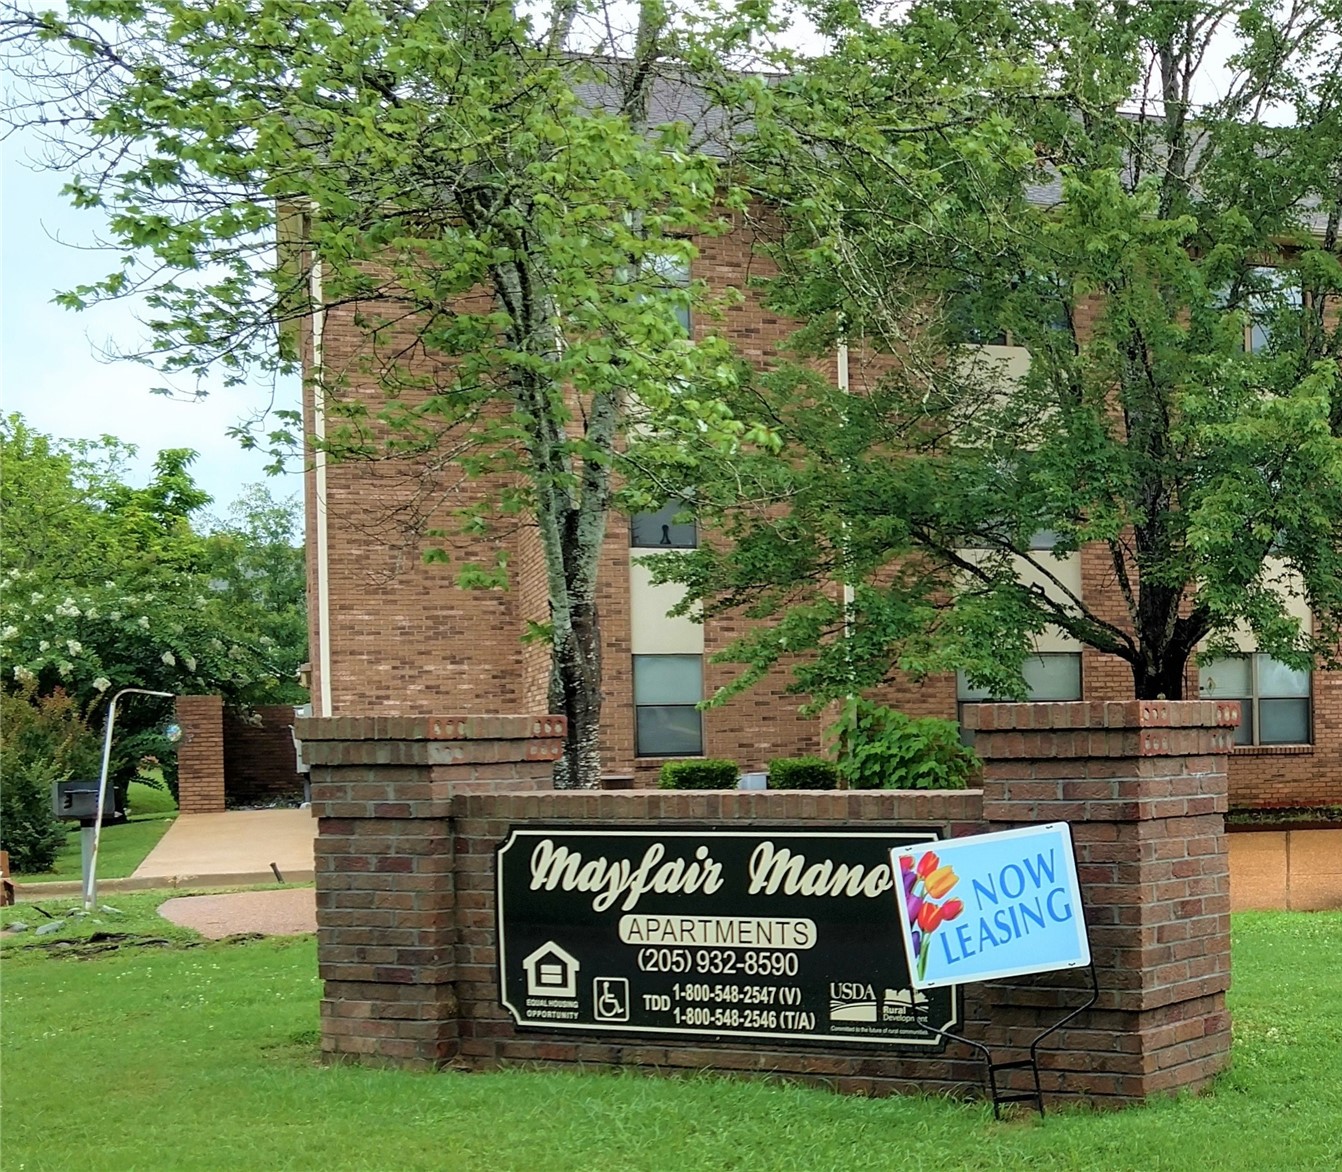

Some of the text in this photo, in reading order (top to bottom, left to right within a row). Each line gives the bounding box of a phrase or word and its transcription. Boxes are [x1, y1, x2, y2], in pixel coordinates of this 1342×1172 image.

[529, 838, 895, 913] Mayfair Mano
[971, 848, 1056, 911] NOW
[626, 917, 810, 947] APARTMENTS
[939, 886, 1073, 965] LEASING
[637, 948, 799, 977] (205) 932-8590
[525, 998, 579, 1009] EQUAL HOUSING
[642, 994, 672, 1012] TDD
[672, 982, 802, 1006] 1-800-548-2547 (V)
[829, 982, 877, 1001] USDA
[525, 1009, 579, 1020] OPPORTUNITY
[672, 1006, 816, 1031] 1-800-548-2546 (T/A)
[882, 1005, 907, 1015] Rural
[829, 1025, 855, 1033] Committed
[868, 1026, 883, 1034] future
[888, 1027, 900, 1035] rural
